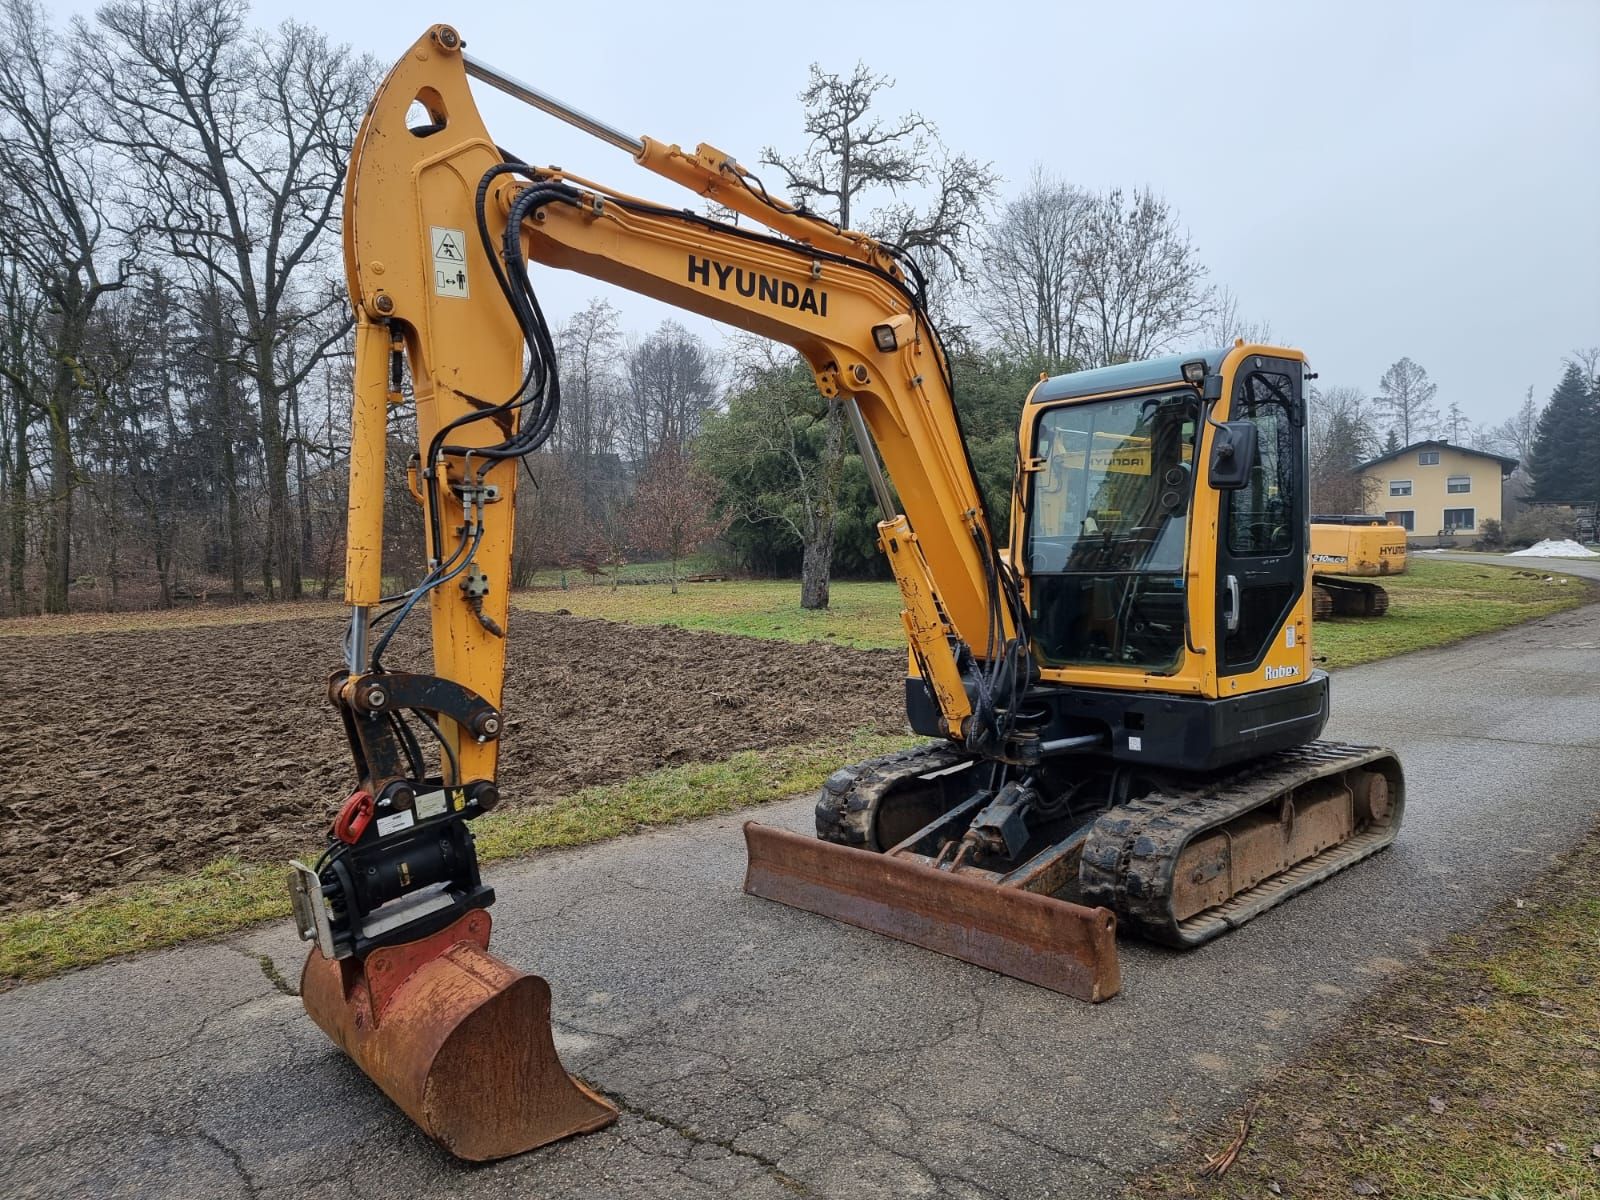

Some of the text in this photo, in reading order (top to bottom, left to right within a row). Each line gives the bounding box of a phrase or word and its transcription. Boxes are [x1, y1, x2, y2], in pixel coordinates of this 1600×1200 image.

[687, 254, 828, 318] HYUNDAI
[1380, 546, 1405, 555] HYUND
[1265, 665, 1299, 680] Robex
